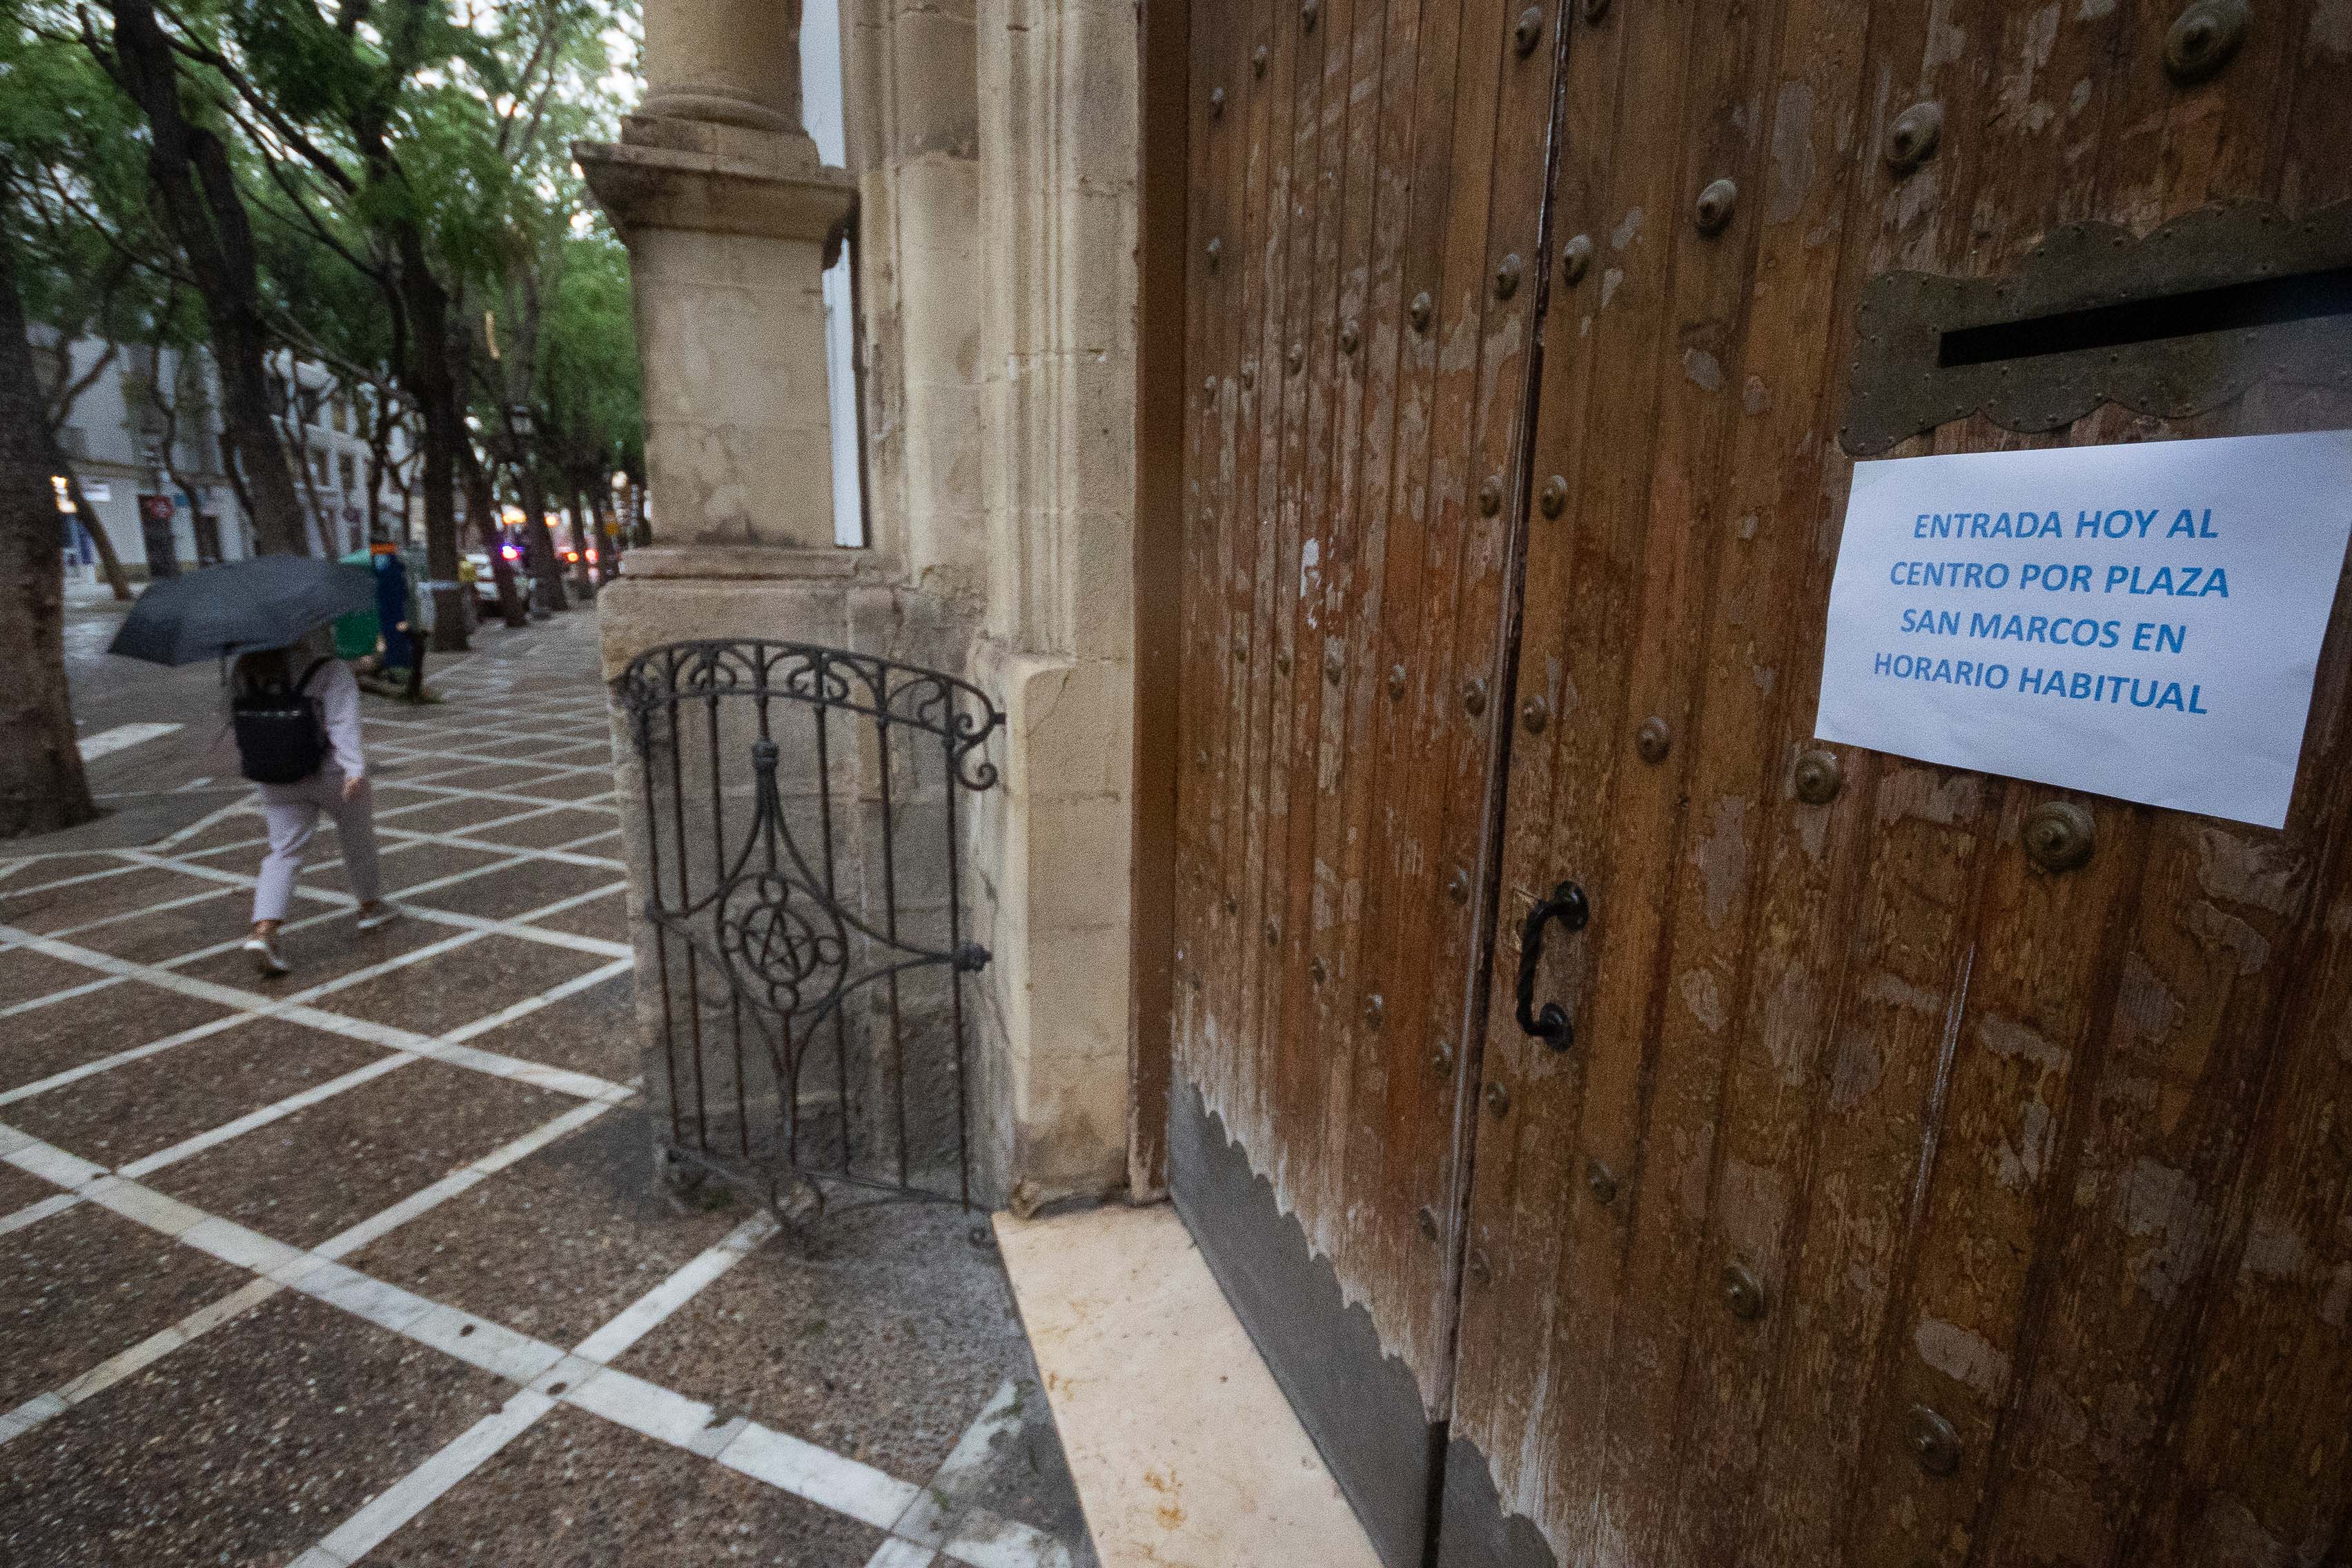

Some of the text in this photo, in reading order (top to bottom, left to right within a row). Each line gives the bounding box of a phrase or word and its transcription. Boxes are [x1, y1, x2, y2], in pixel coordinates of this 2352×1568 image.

[1914, 508, 2219, 539] ENTRADA HOY AL
[1891, 562, 2229, 598] CENTRO POR PLAZA
[1901, 609, 2186, 654] SAN MARCOS EN
[1875, 654, 2207, 715] HORARIO HABITUAL
